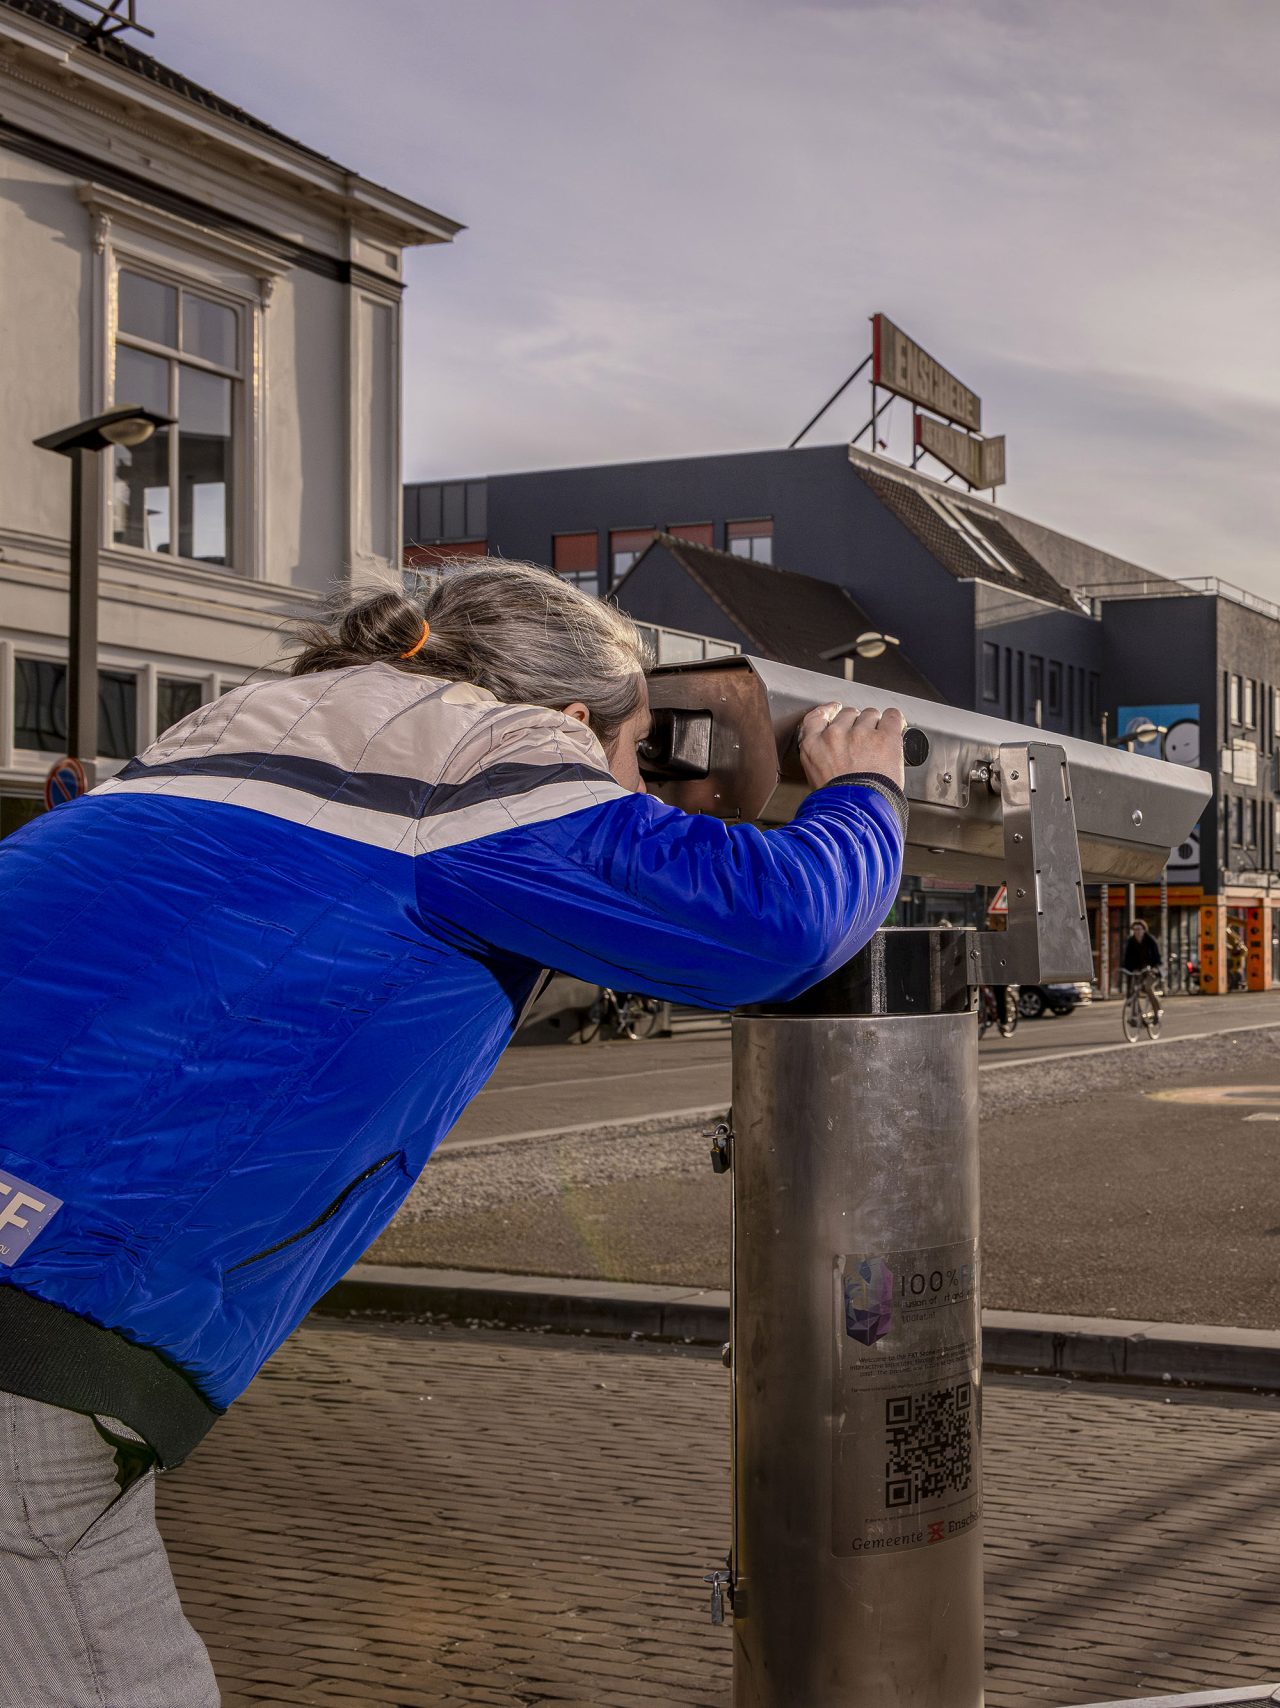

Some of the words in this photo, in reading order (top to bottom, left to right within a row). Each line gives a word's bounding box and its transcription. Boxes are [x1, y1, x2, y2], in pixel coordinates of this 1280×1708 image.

[894, 331, 973, 417] ENSCHEDE
[902, 1298, 927, 1309] usion
[852, 1530, 923, 1551] Gemeente
